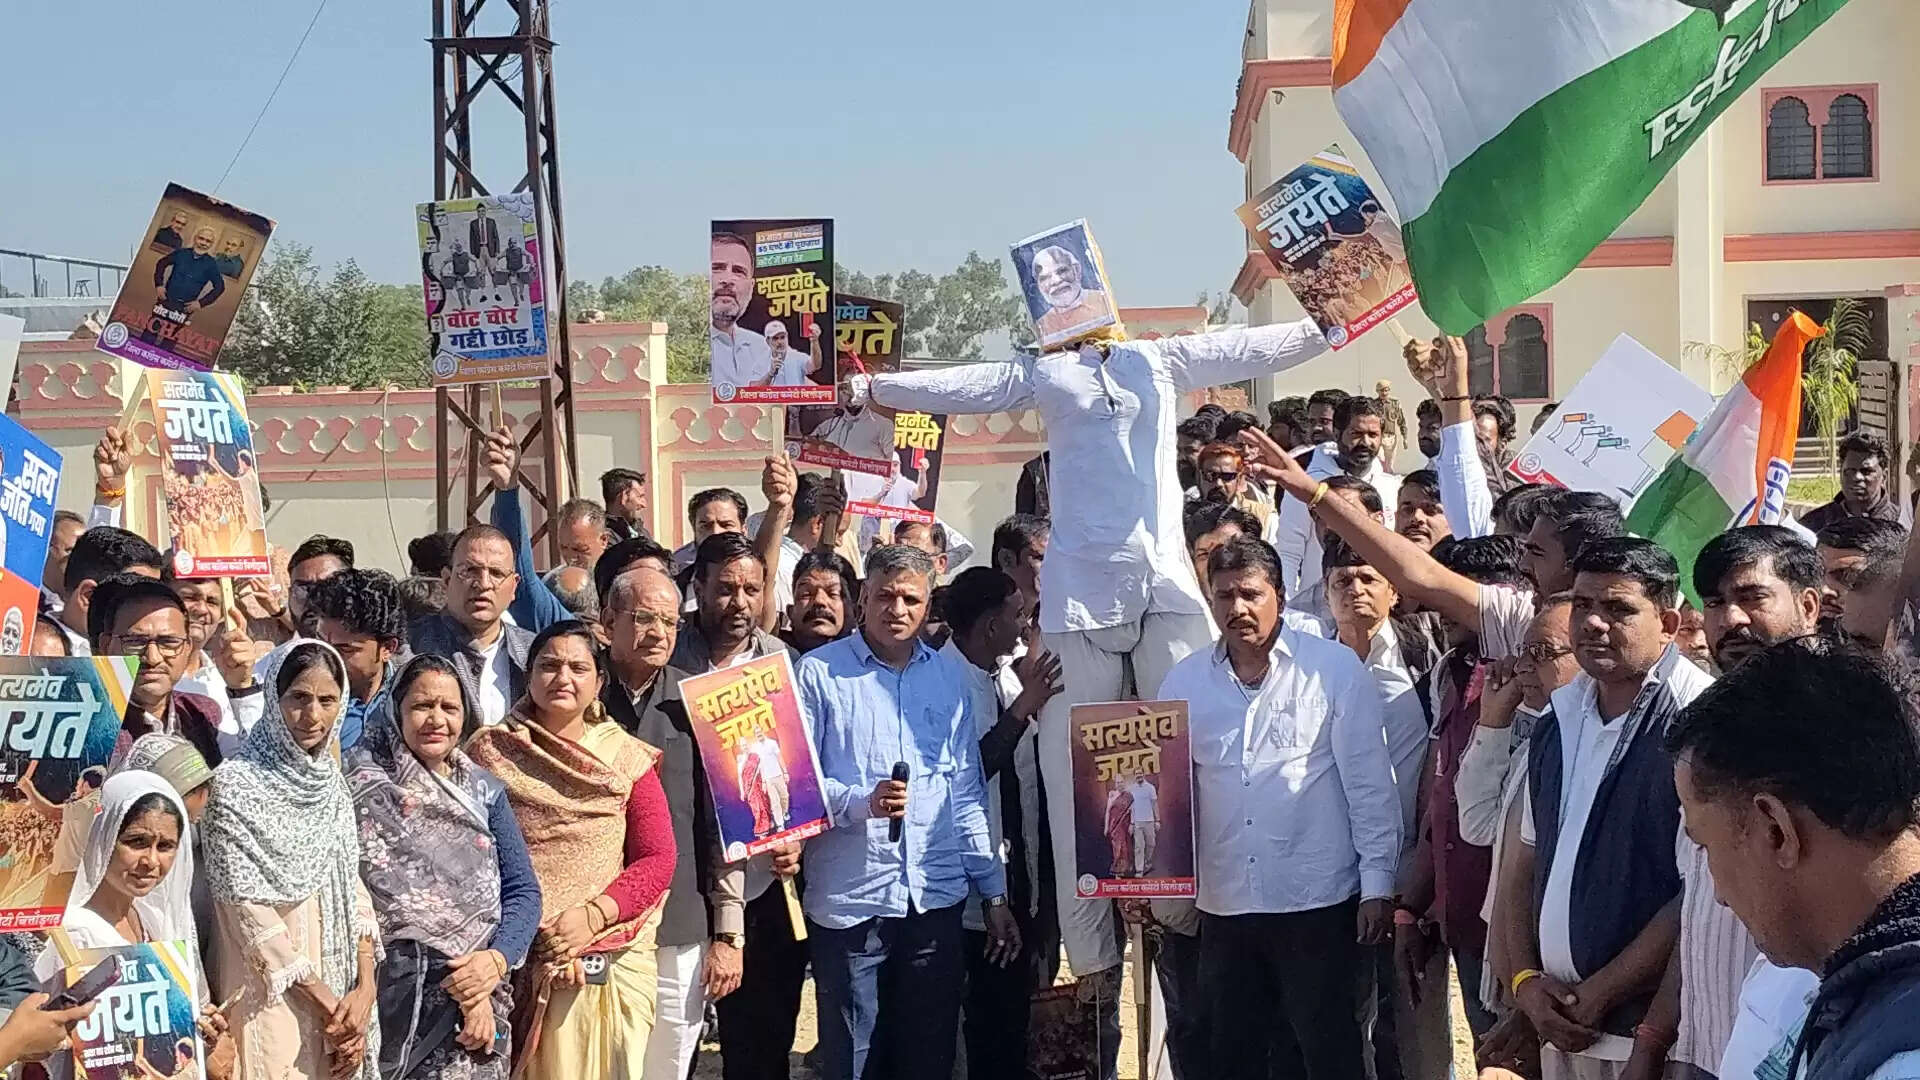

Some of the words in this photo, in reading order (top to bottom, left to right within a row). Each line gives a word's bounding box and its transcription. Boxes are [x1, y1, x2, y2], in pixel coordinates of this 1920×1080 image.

[1254, 178, 1307, 219] सत्यमेव
[1256, 173, 1350, 249] जयते
[756, 268, 816, 295] सत्यमेव
[767, 278, 830, 317] जयते
[445, 308, 481, 328] वोट
[485, 305, 518, 325] चोर
[448, 327, 488, 349] गद्दी
[161, 377, 206, 400] सत्यमेव
[157, 387, 234, 444] जयते
[22, 449, 58, 506] सत्य
[2, 476, 33, 527] जीत
[28, 508, 47, 538] गया
[0, 667, 66, 699] त्यमेव
[696, 664, 783, 723] सत्यमेव
[1080, 705, 1179, 751] सत्यमेव
[1094, 740, 1161, 782] जयते
